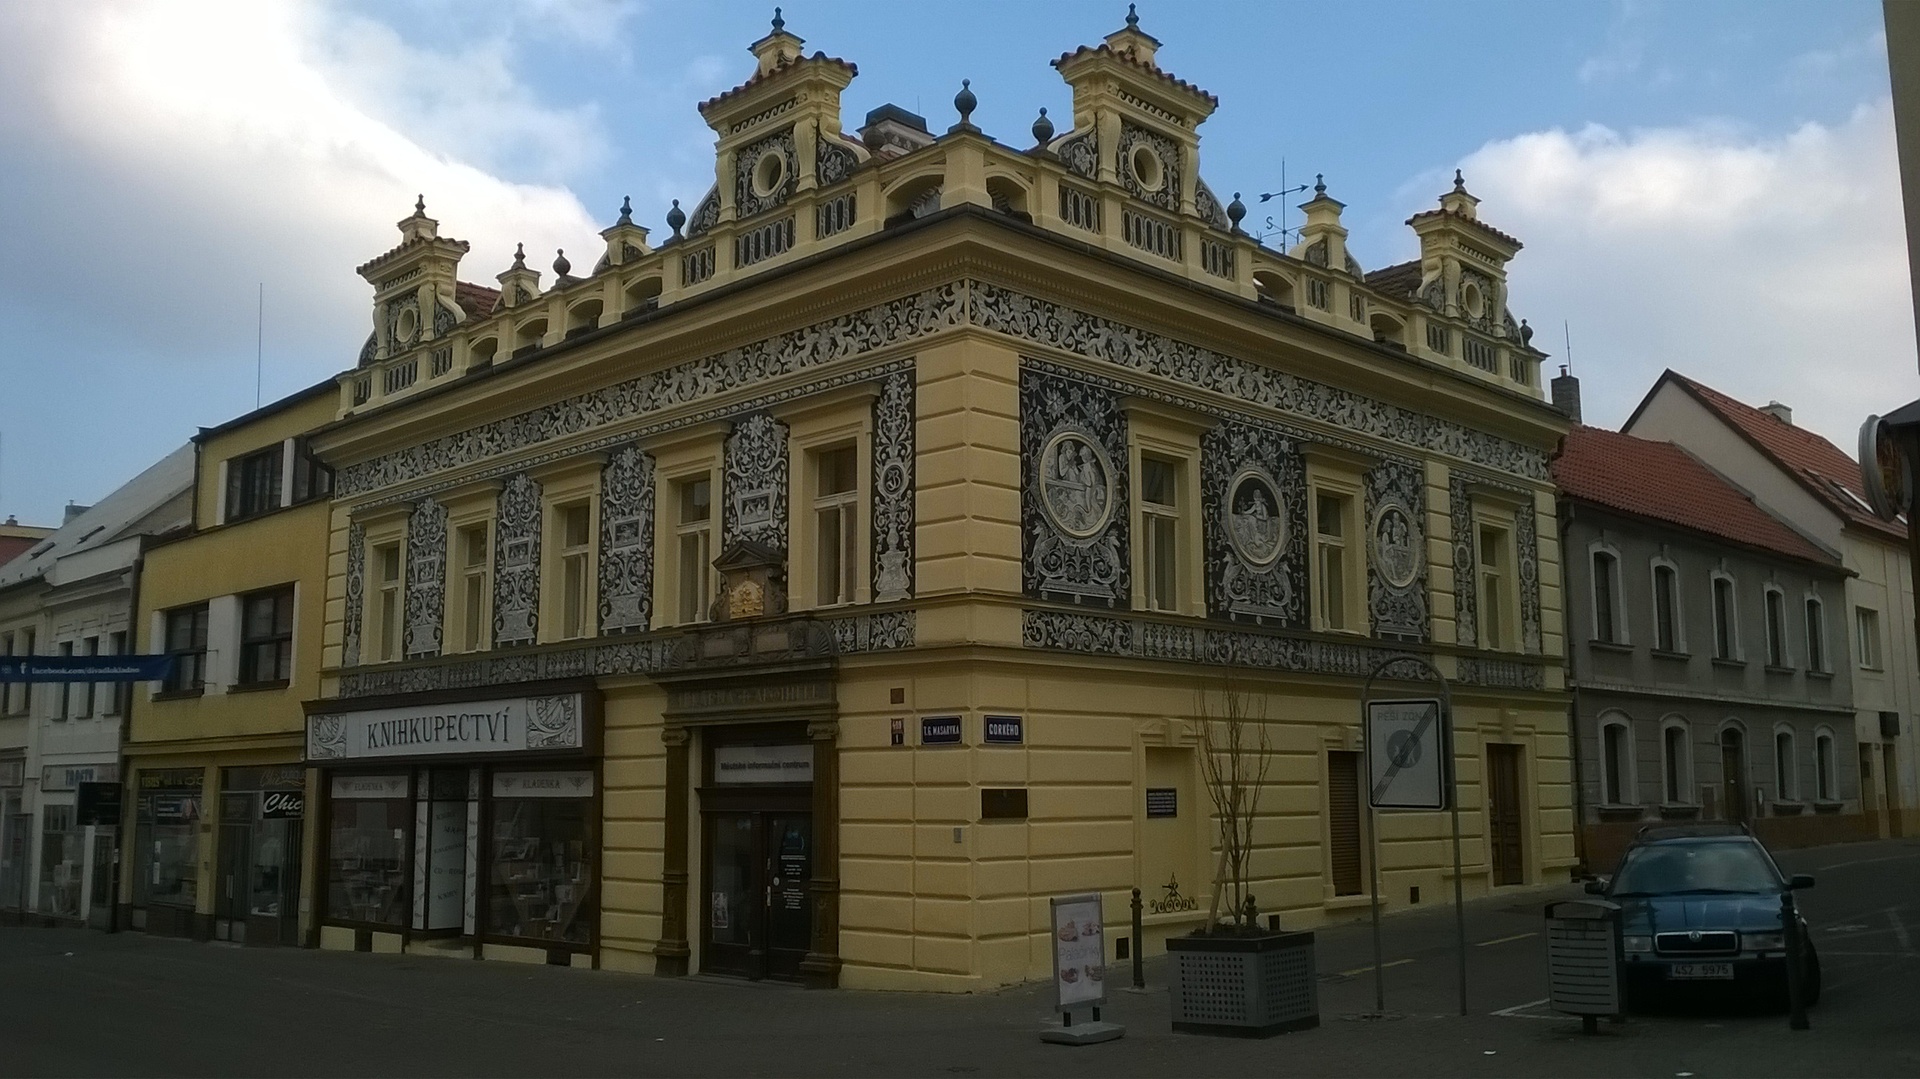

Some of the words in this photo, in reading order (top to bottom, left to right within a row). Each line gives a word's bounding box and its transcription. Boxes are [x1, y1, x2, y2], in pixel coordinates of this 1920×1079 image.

[367, 706, 511, 750] KNIHKUPECTVÍ
[933, 724, 960, 736] MASARYKA
[263, 793, 303, 813] Chic
